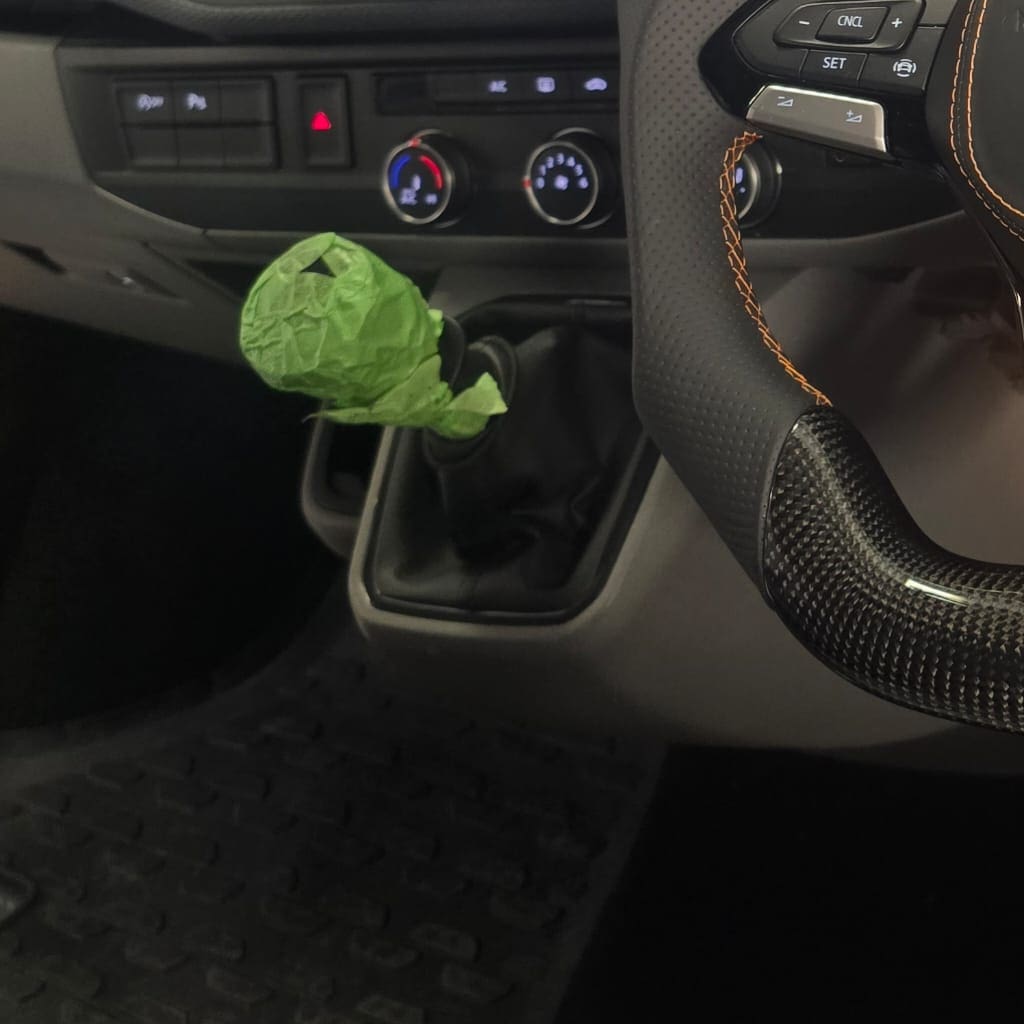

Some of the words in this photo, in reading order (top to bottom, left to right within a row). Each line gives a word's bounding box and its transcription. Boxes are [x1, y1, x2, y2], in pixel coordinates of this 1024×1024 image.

[837, 15, 864, 28] CNCL
[822, 57, 847, 70] SET
[556, 153, 565, 165] 3
